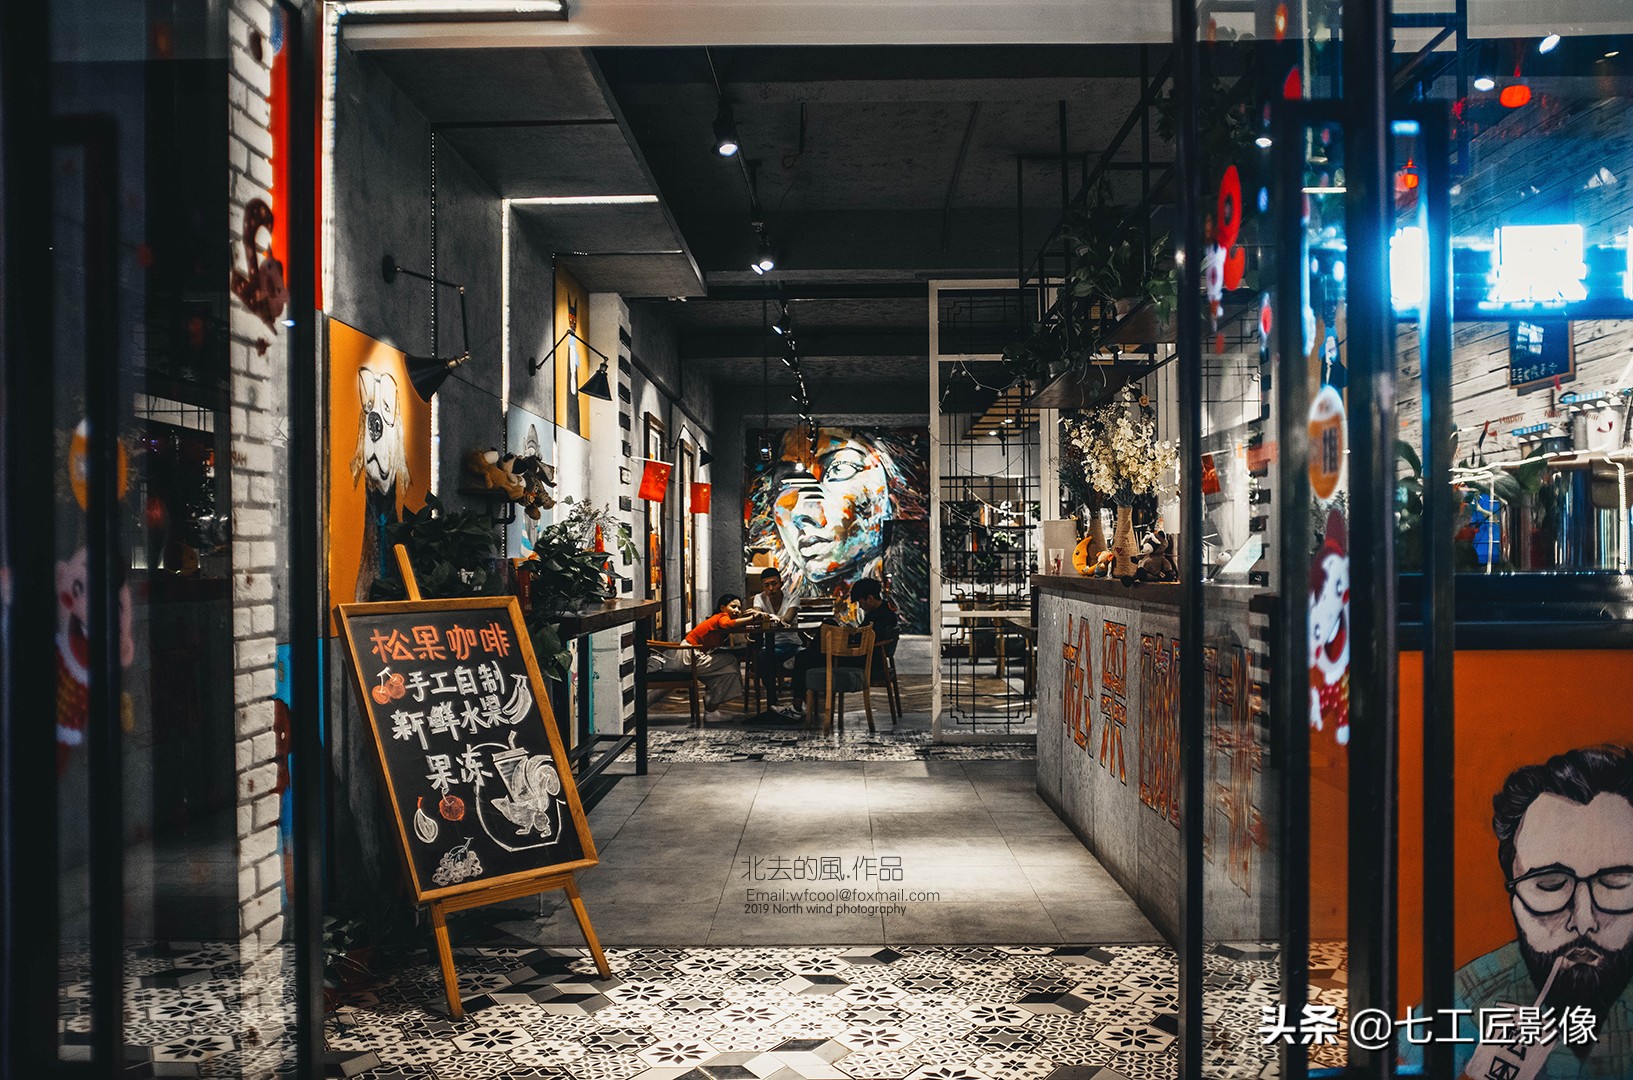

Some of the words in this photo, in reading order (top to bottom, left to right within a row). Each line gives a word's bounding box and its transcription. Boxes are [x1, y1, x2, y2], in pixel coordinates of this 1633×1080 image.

[369, 622, 511, 663] 松果咖啡
[405, 660, 505, 702] 手工自制
[390, 693, 510, 750] 新鲜水果
[425, 744, 493, 790] 果冻
